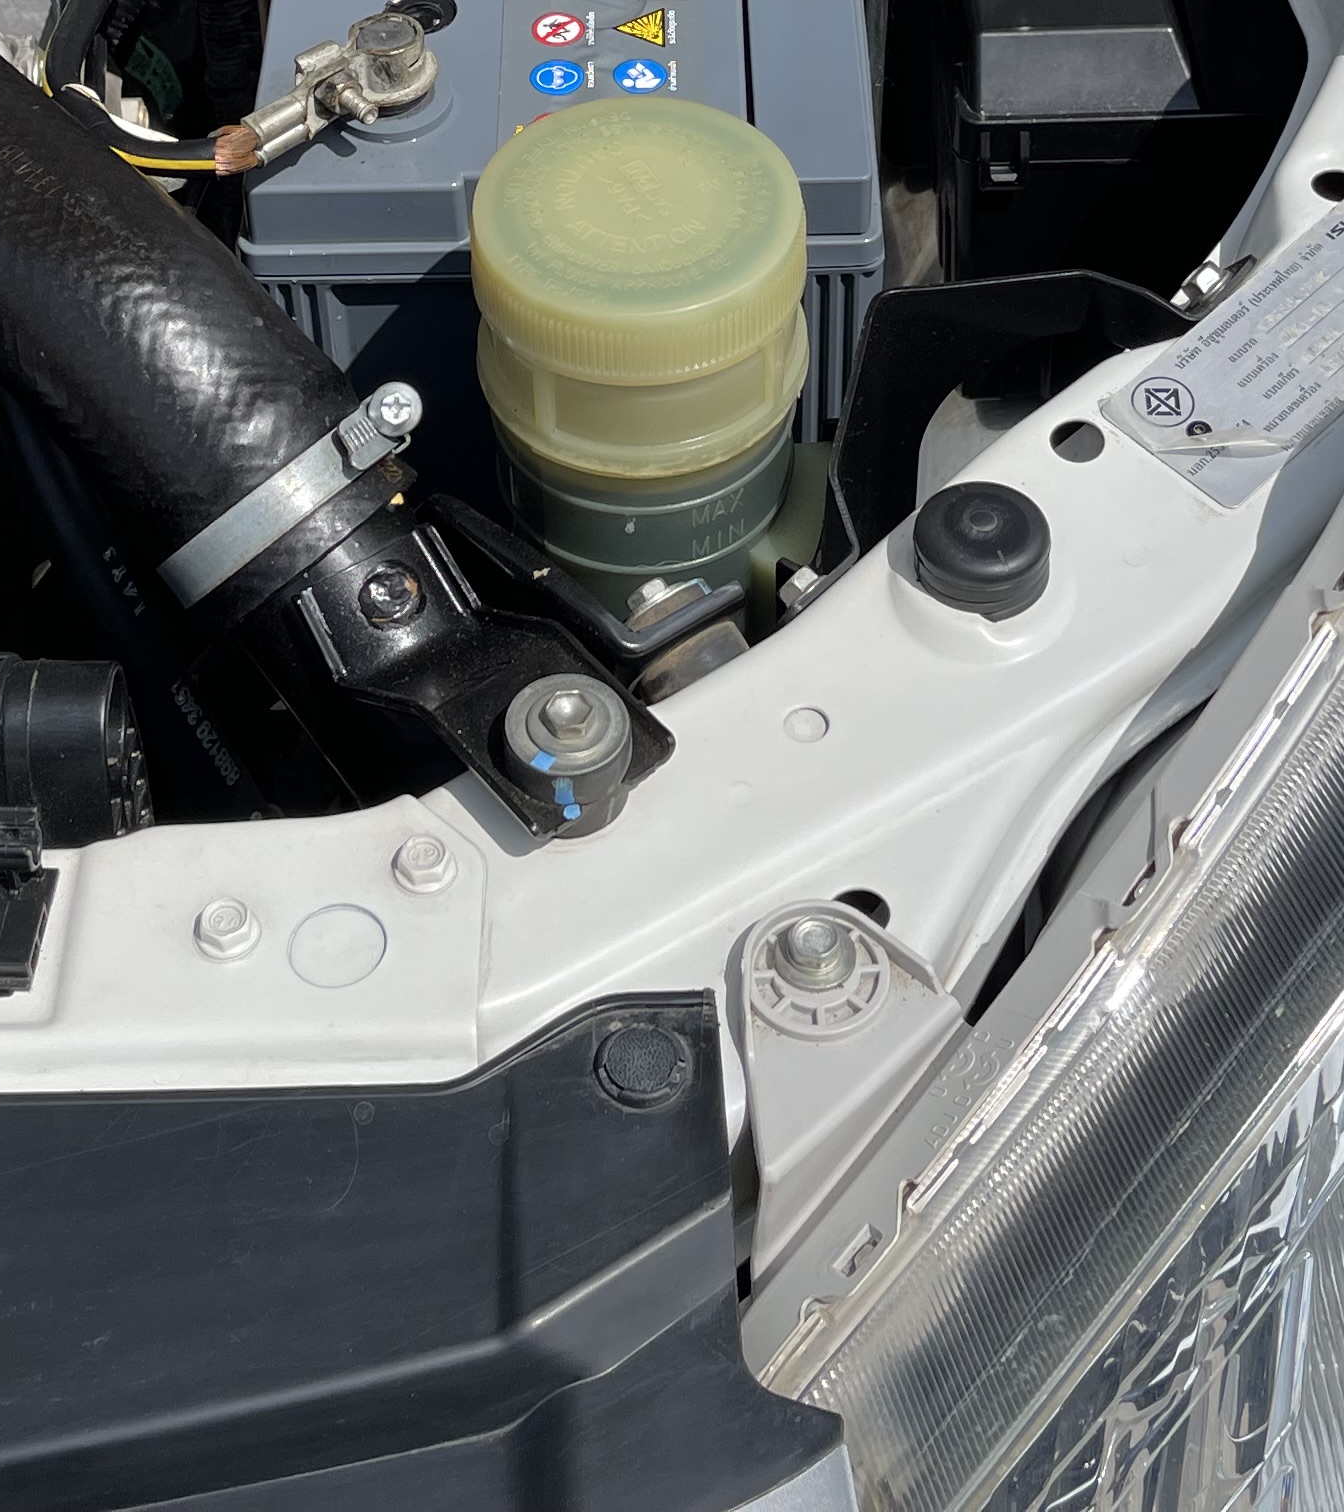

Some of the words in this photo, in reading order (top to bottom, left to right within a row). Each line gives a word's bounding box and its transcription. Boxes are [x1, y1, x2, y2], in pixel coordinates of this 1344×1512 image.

[563, 217, 707, 255] ATTENTION
[691, 487, 745, 529] MAX
[691, 518, 745, 559] MIN
